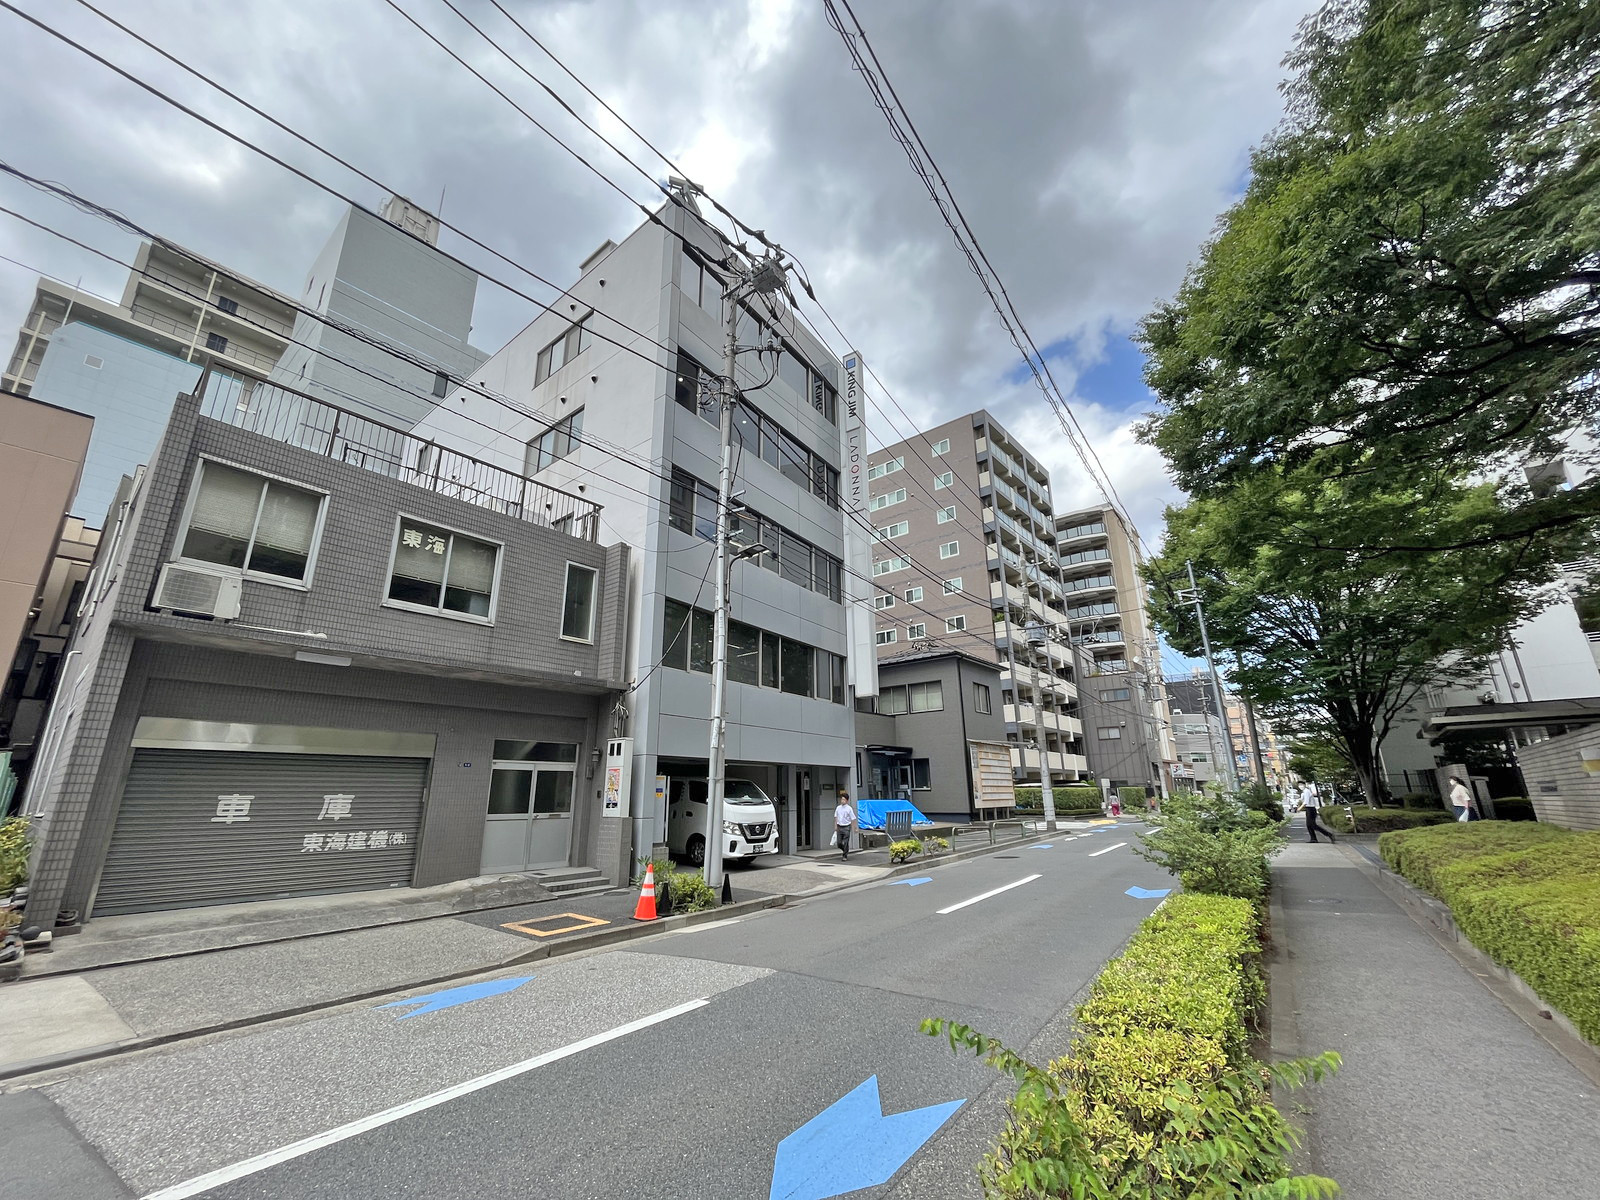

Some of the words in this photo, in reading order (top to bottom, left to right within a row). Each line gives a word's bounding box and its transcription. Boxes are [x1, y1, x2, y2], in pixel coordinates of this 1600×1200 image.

[848, 370, 856, 399] KING
[849, 435, 861, 507] LADONNA
[402, 529, 446, 555] 東海
